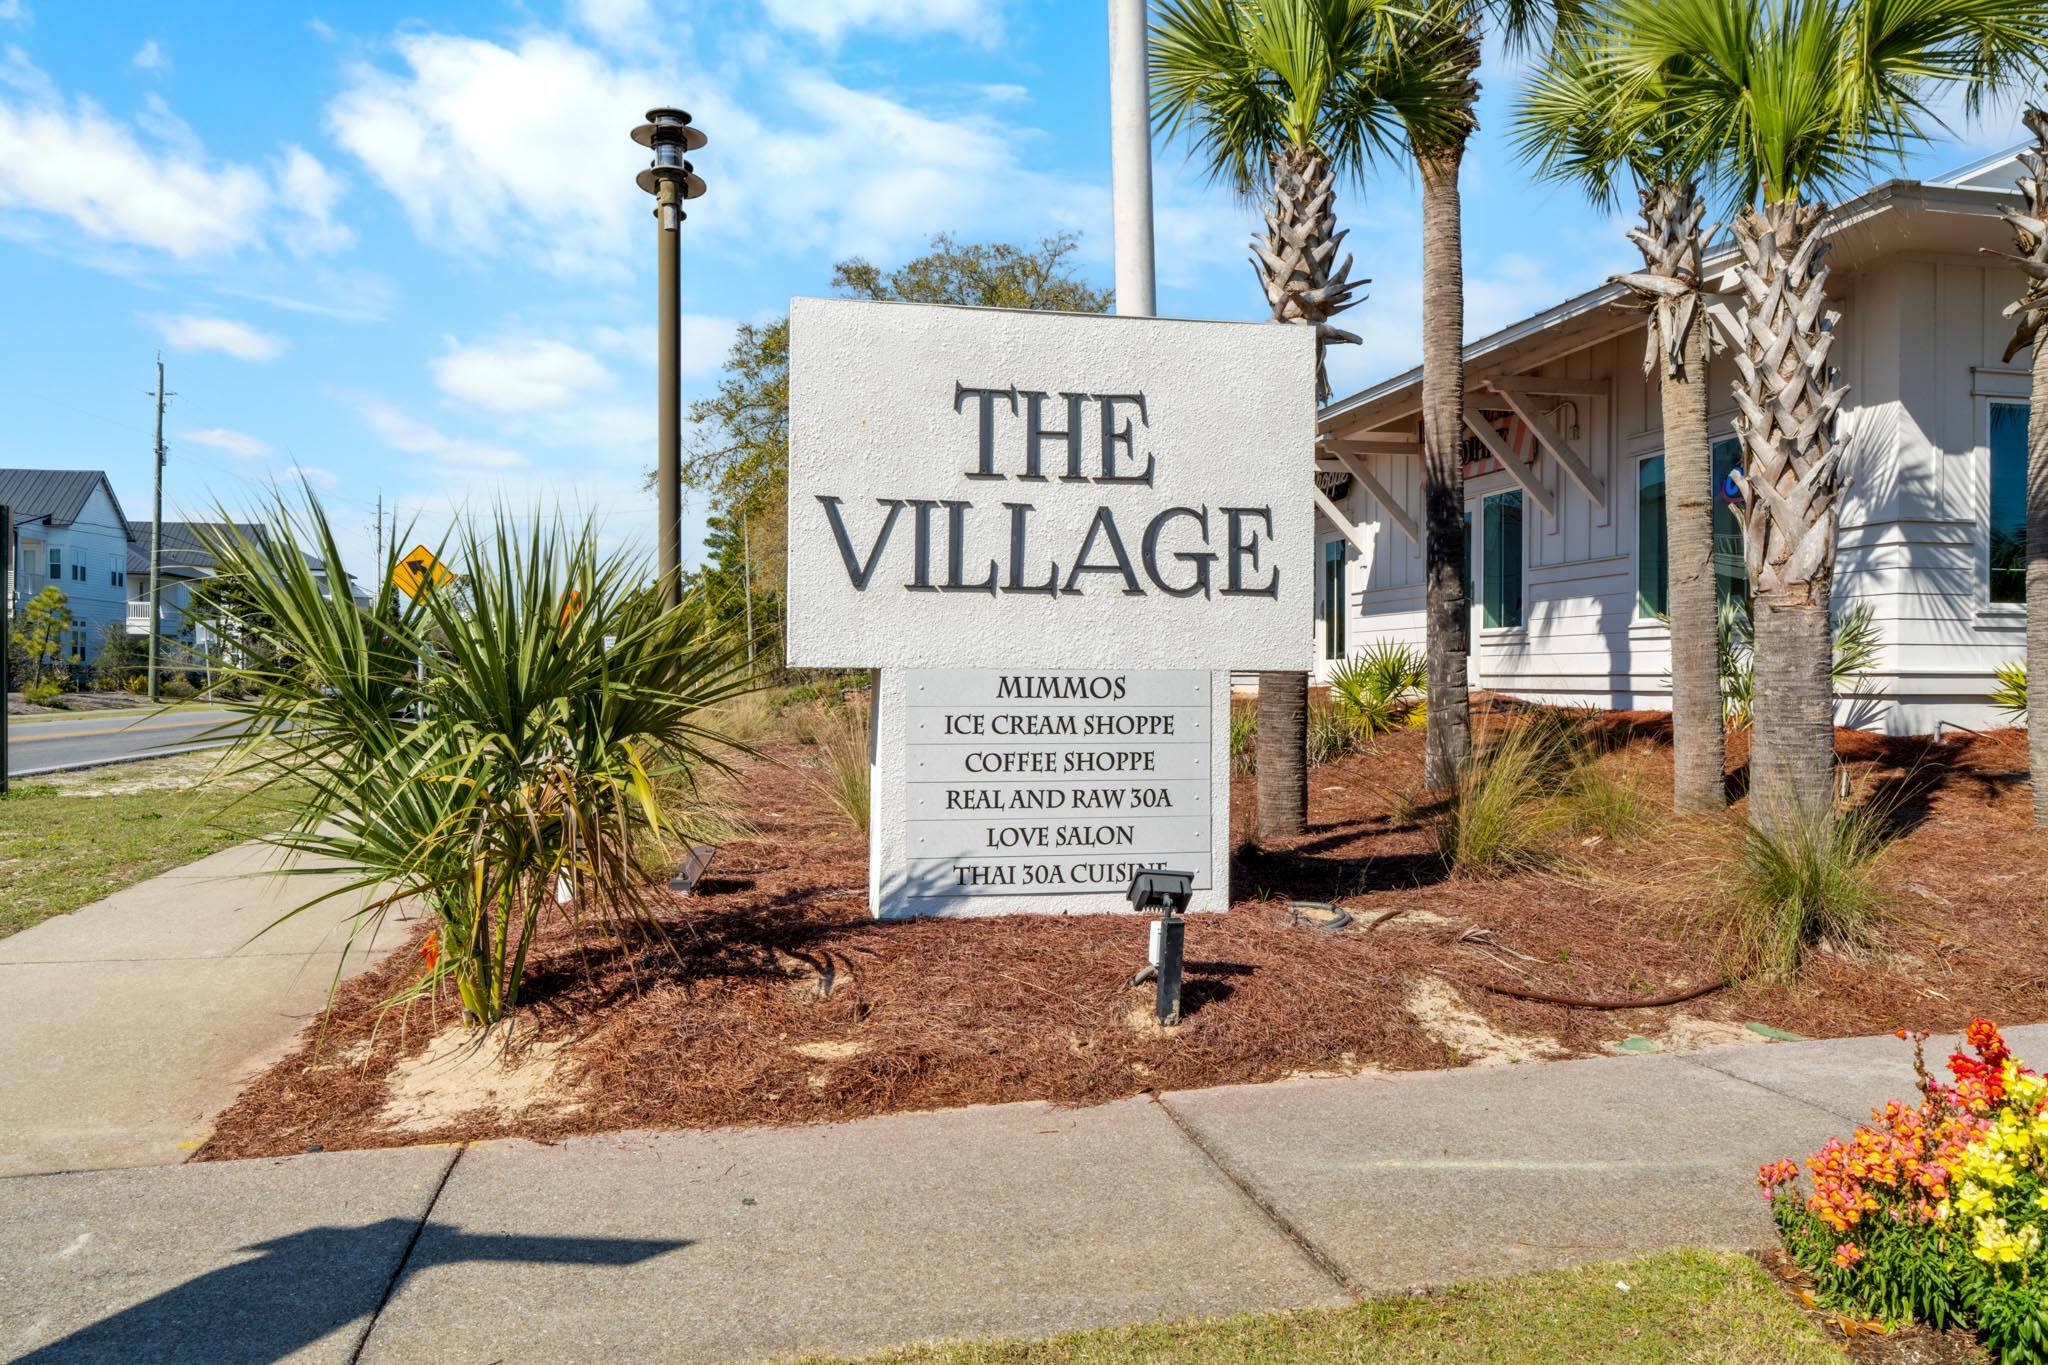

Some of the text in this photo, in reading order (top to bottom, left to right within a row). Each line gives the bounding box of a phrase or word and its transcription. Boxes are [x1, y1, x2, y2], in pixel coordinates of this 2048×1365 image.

[953, 379, 1156, 488] THE
[814, 494, 1281, 602] VILLAGE
[996, 674, 1126, 702] MIMMOS
[944, 713, 1175, 737] ICE CREAM SHOPPE
[965, 750, 1156, 774] COFFEE SHOPPE
[946, 788, 1173, 811] REAL AND RAW 30A
[987, 825, 1134, 850] LOVE SALON
[953, 861, 1168, 886] THAI 30A CUISI
